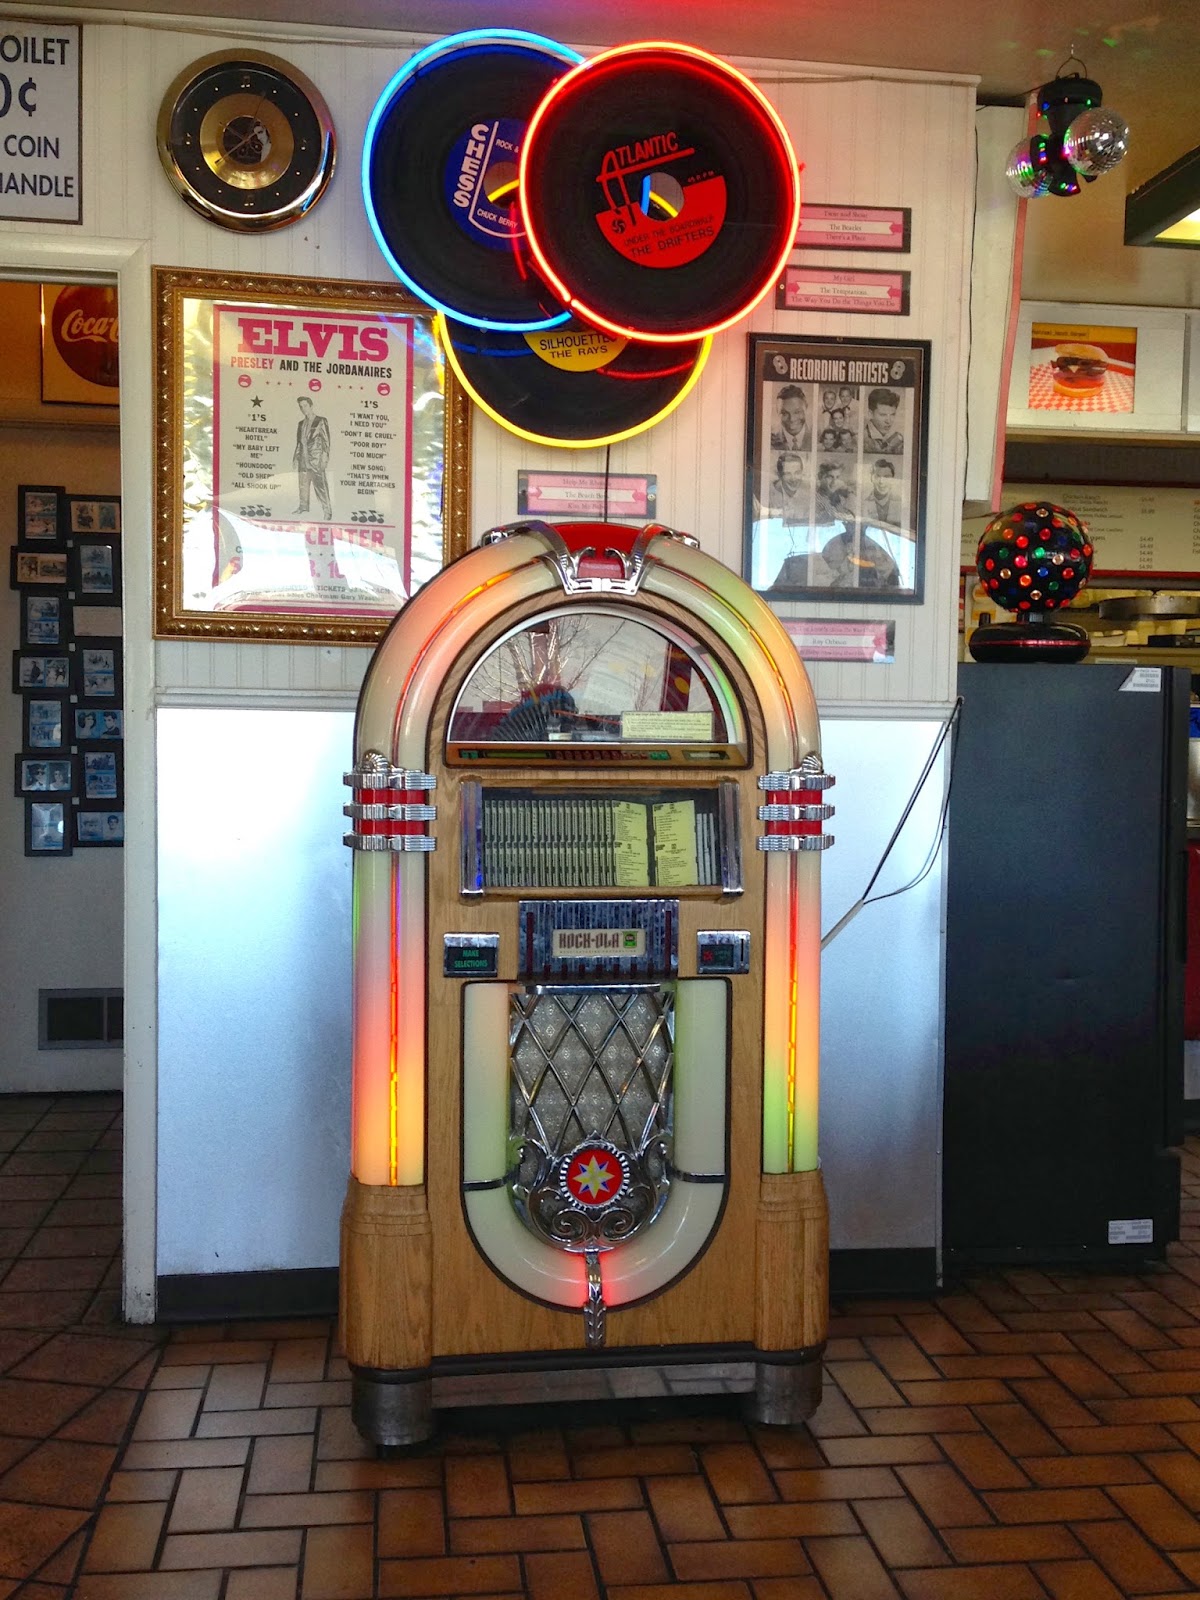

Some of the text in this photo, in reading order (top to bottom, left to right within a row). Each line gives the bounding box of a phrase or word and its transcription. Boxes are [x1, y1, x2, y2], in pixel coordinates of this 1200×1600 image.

[4, 134, 60, 159] COIN
[496, 138, 513, 151] ROCK
[453, 123, 489, 208] CHESS
[596, 132, 694, 214] ATLANTIC
[477, 207, 519, 229] CHUCK BERRY
[631, 226, 715, 258] THE DRIFTERS
[805, 296, 818, 304] Way
[832, 287, 867, 296] Temptations
[238, 318, 389, 362] ELVIS
[549, 345, 608, 358] THE RAYS
[230, 356, 392, 379] PRESLEY AND THE JORDANAIRES
[790, 357, 889, 384] RECORDING ARTISTS
[375, 414, 390, 422] YOU,
[245, 434, 268, 442] HOTEL"
[374, 432, 397, 440] CRUEL"
[305, 526, 385, 548] CENTER
[454, 959, 488, 968] SELECTIONS
